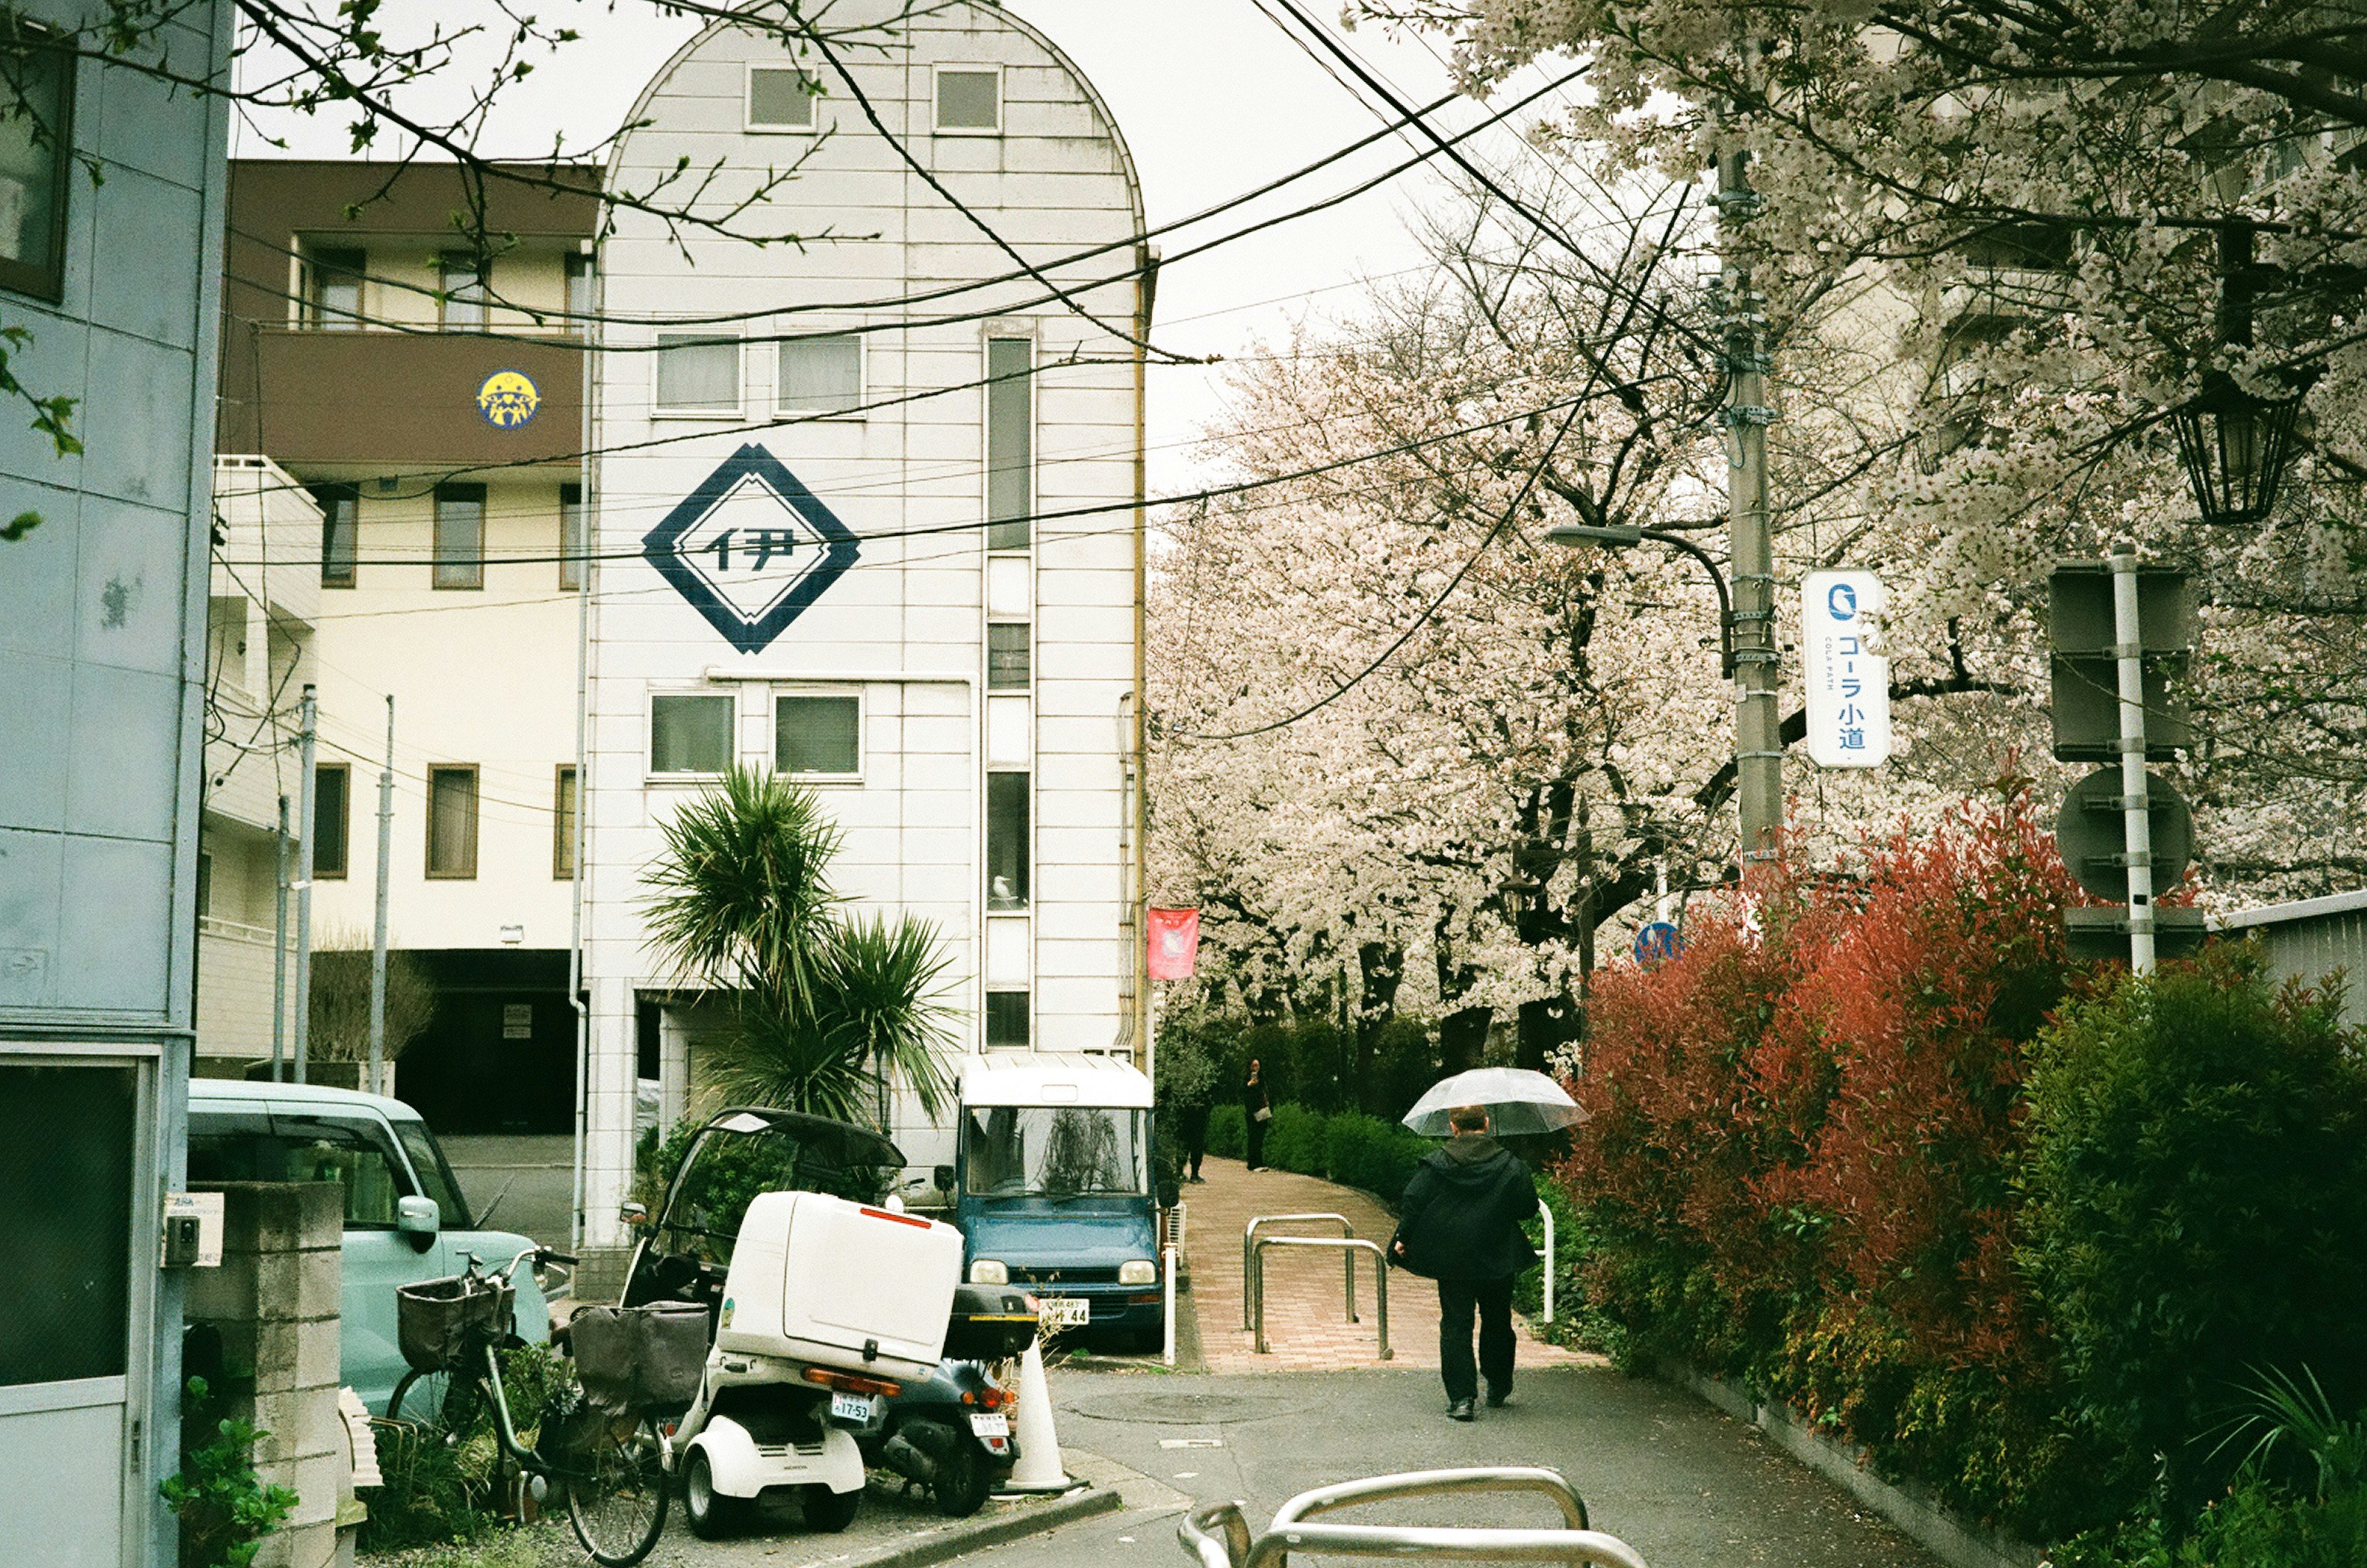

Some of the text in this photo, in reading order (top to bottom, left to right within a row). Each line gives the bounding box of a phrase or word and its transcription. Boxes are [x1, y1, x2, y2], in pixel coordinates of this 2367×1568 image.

[704, 528, 800, 572] 伊
[1826, 665, 1834, 691] PATH
[1839, 636, 1865, 750] コーラ小道
